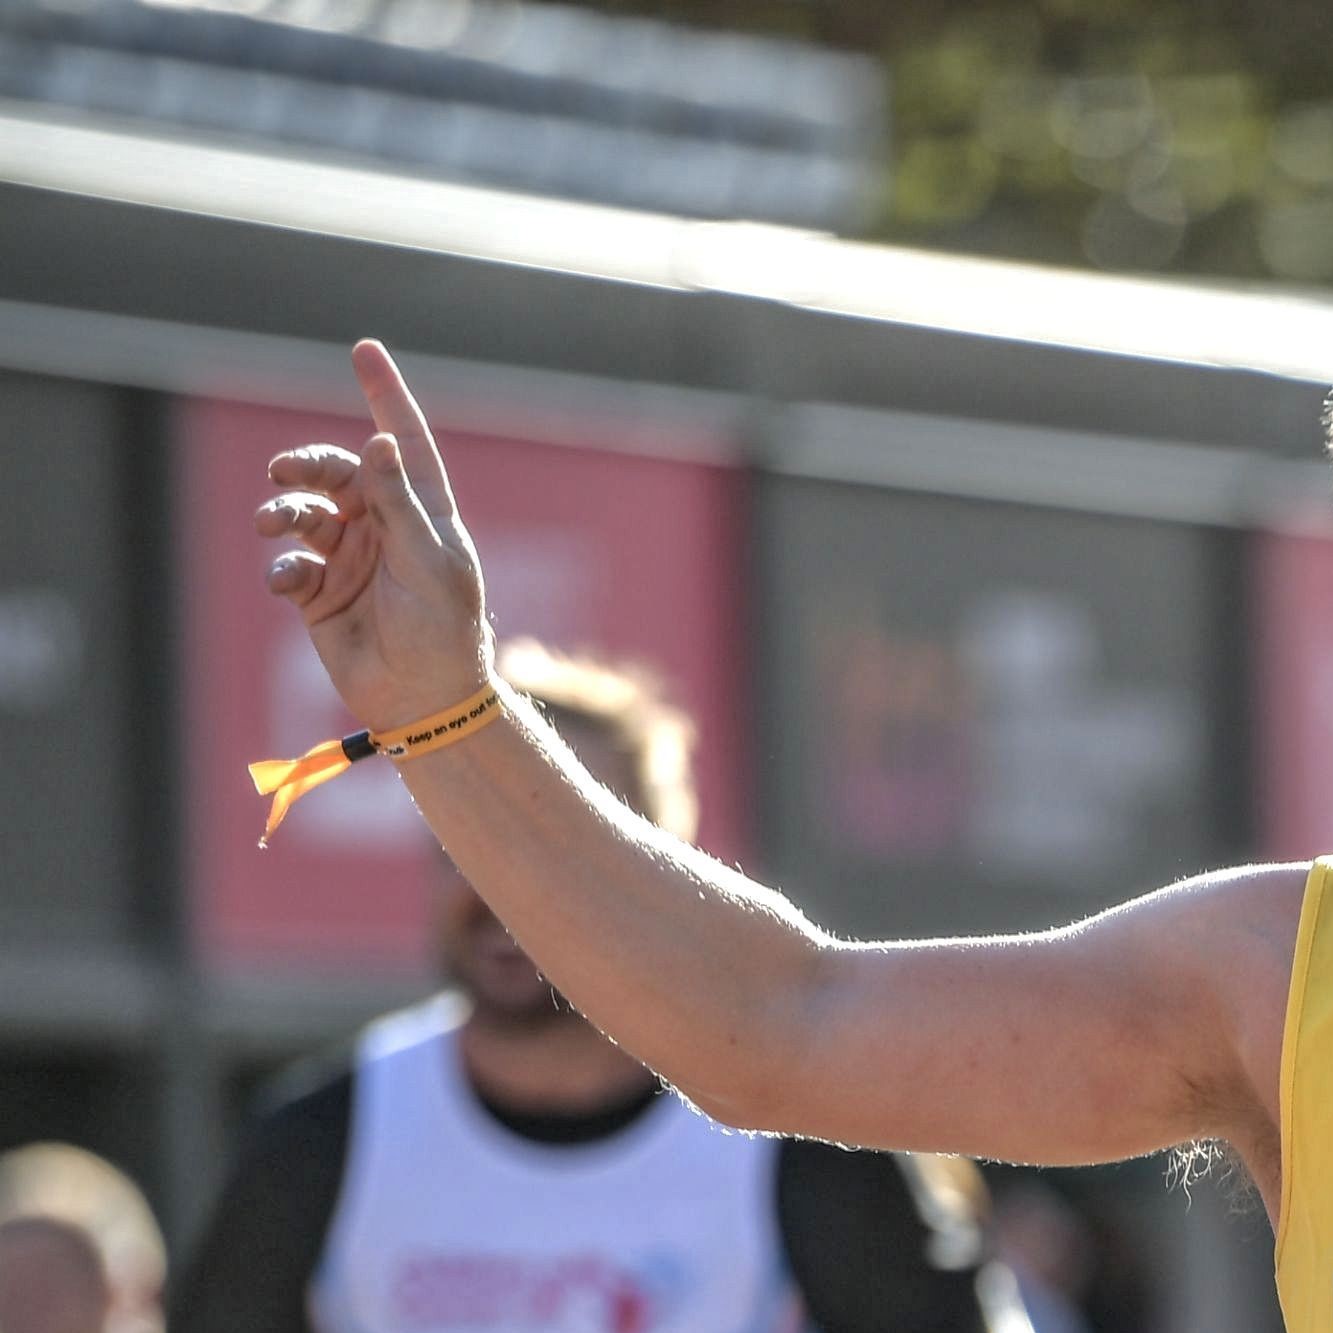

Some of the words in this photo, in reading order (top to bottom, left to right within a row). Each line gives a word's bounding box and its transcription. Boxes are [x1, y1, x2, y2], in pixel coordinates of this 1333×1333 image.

[406, 731, 433, 745] Keep
[434, 725, 448, 735] an
[449, 716, 468, 728] eye
[469, 703, 486, 719] out
